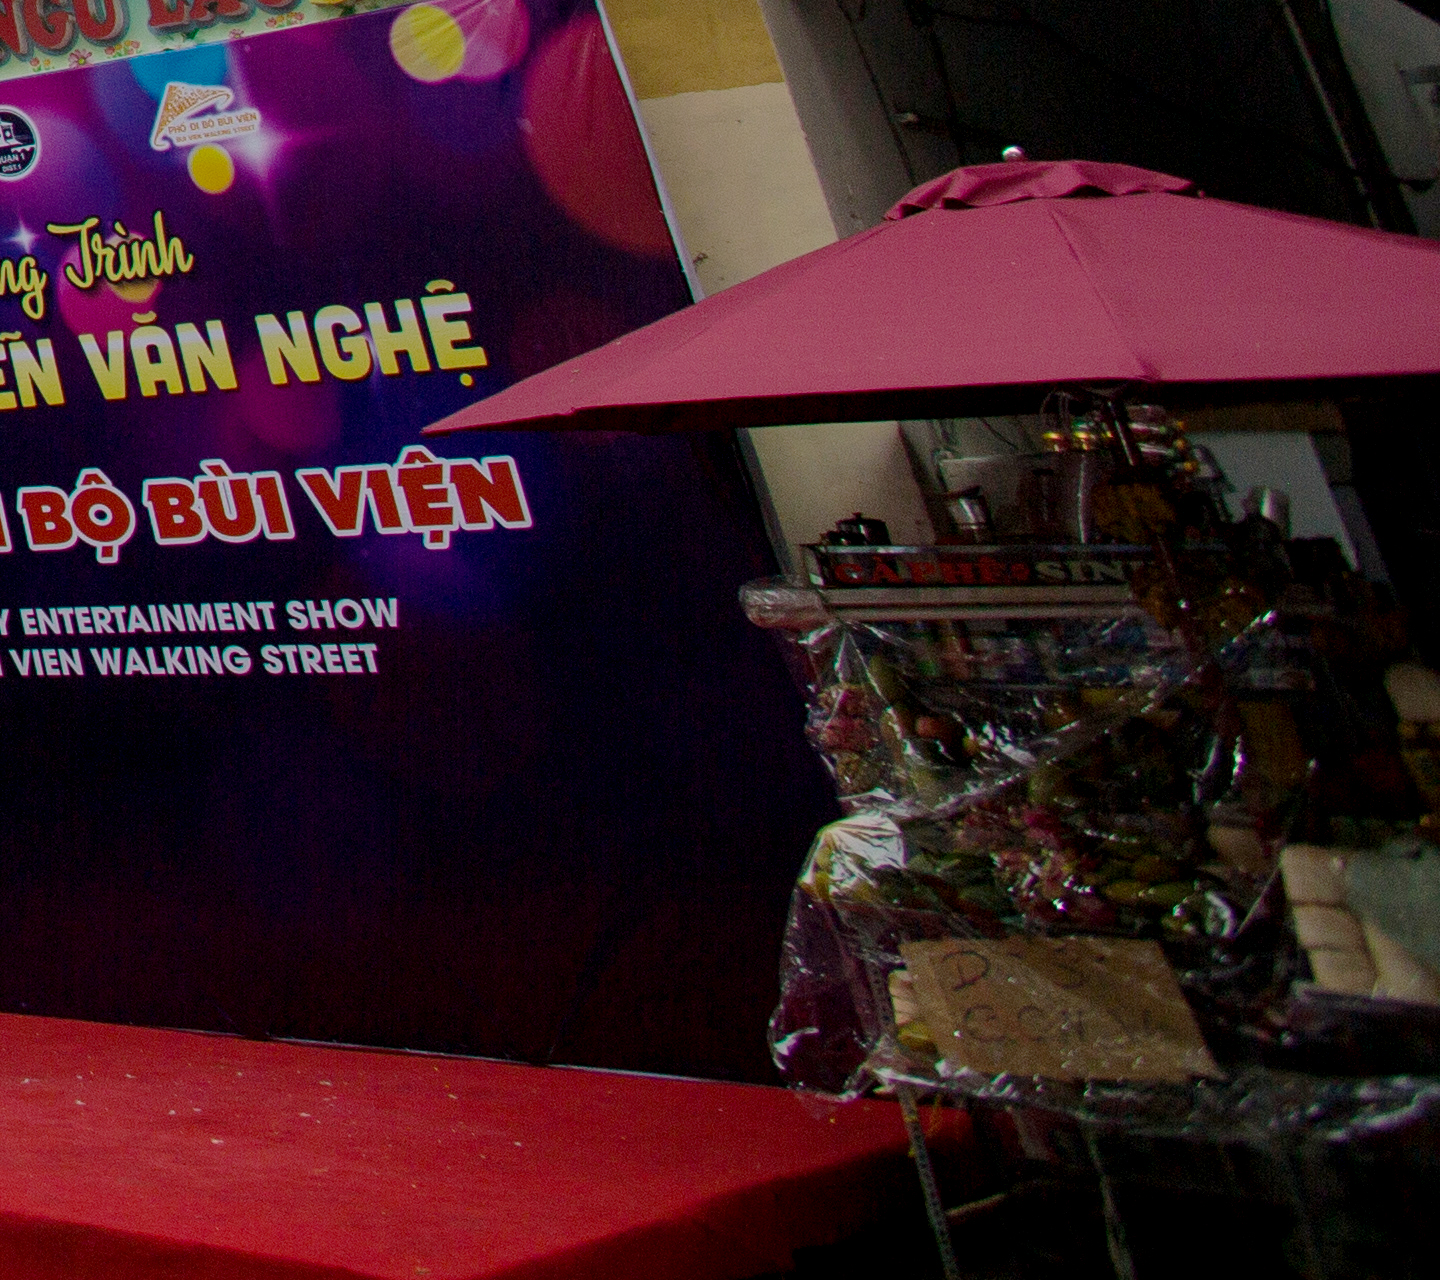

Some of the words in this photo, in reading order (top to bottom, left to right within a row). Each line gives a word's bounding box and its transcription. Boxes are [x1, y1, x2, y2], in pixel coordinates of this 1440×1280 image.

[46, 210, 194, 289] Trình
[78, 311, 238, 400] VĂN
[255, 279, 488, 386] NGHỆ
[17, 467, 135, 564] BỘ
[142, 458, 294, 546] BÙI
[296, 444, 533, 550] VIỆN
[19, 601, 275, 635] ENTERTAINMENT
[284, 597, 399, 630] SHOW
[10, 647, 84, 676] VIEN
[91, 644, 251, 676] WALKING
[262, 643, 379, 675] STREET
